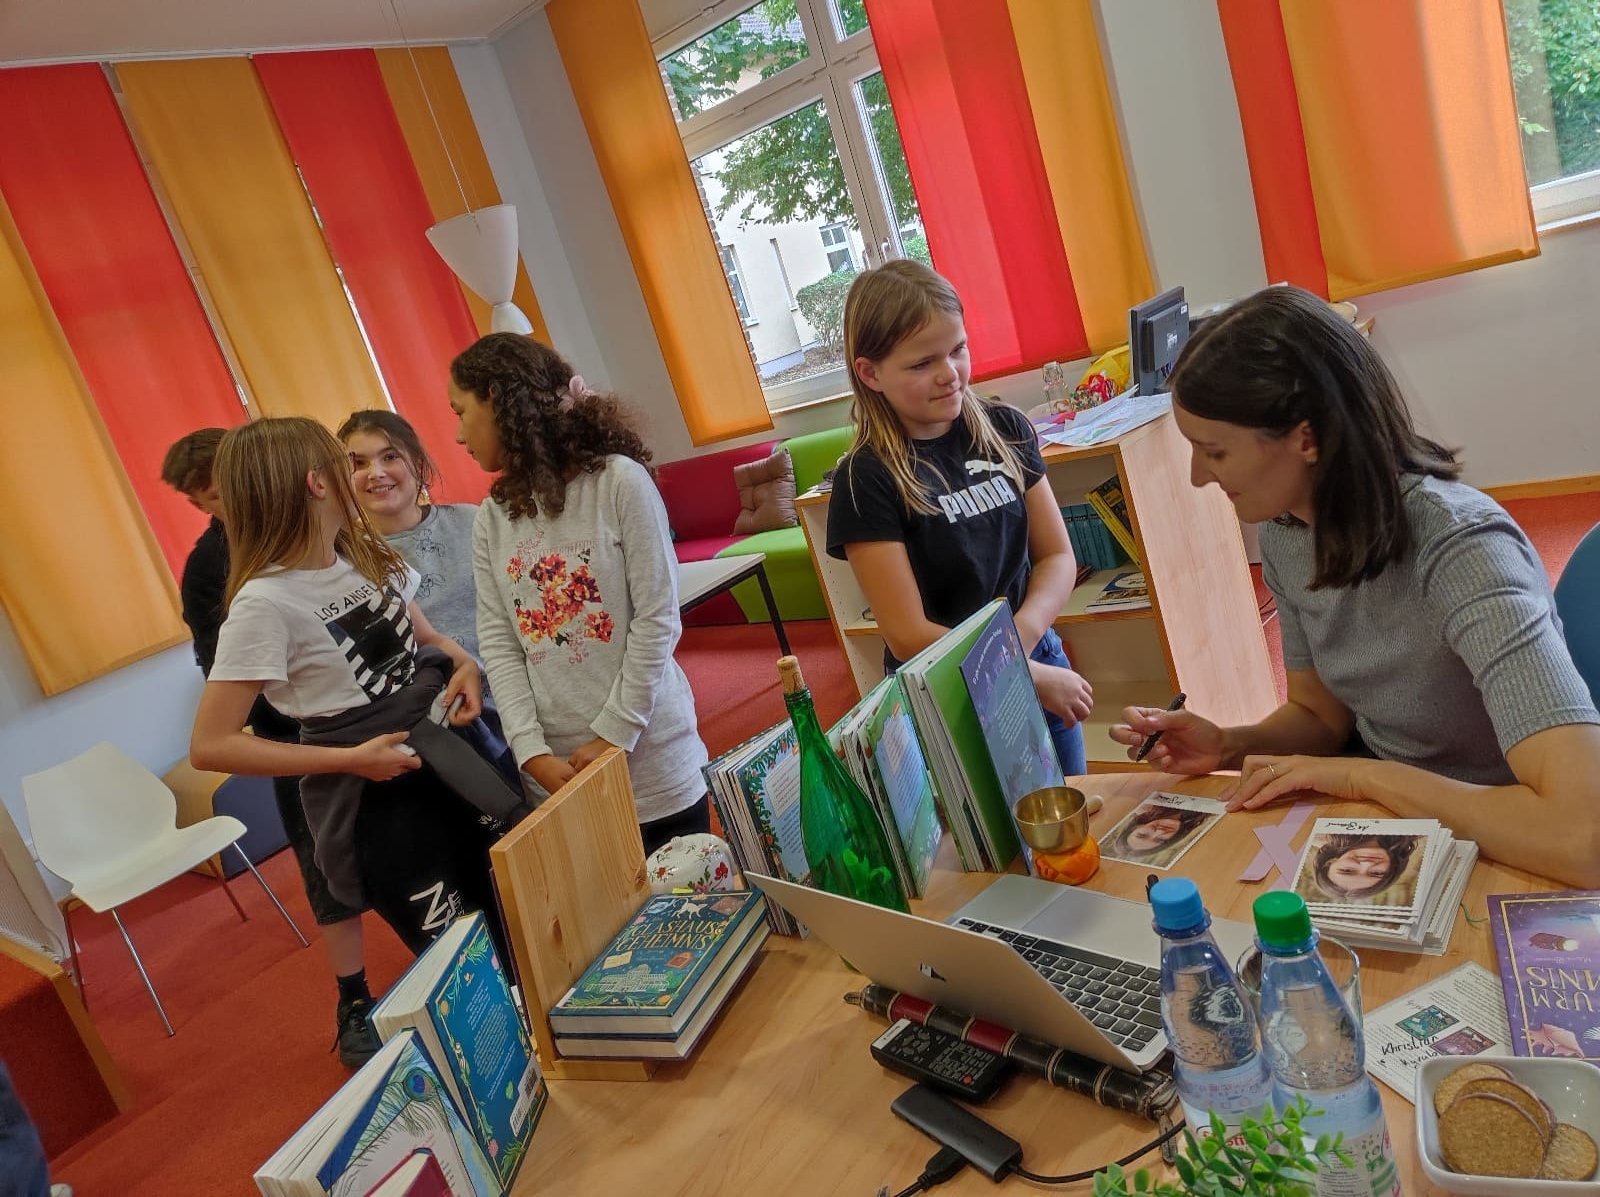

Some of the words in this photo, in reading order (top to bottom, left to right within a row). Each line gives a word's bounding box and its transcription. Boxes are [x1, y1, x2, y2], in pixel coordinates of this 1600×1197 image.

[937, 475, 1017, 524] PUMA
[314, 602, 340, 621] LOS
[343, 583, 379, 609] ANGEL
[615, 933, 712, 951] GEHEIMNIS
[1530, 986, 1597, 1012] URM
